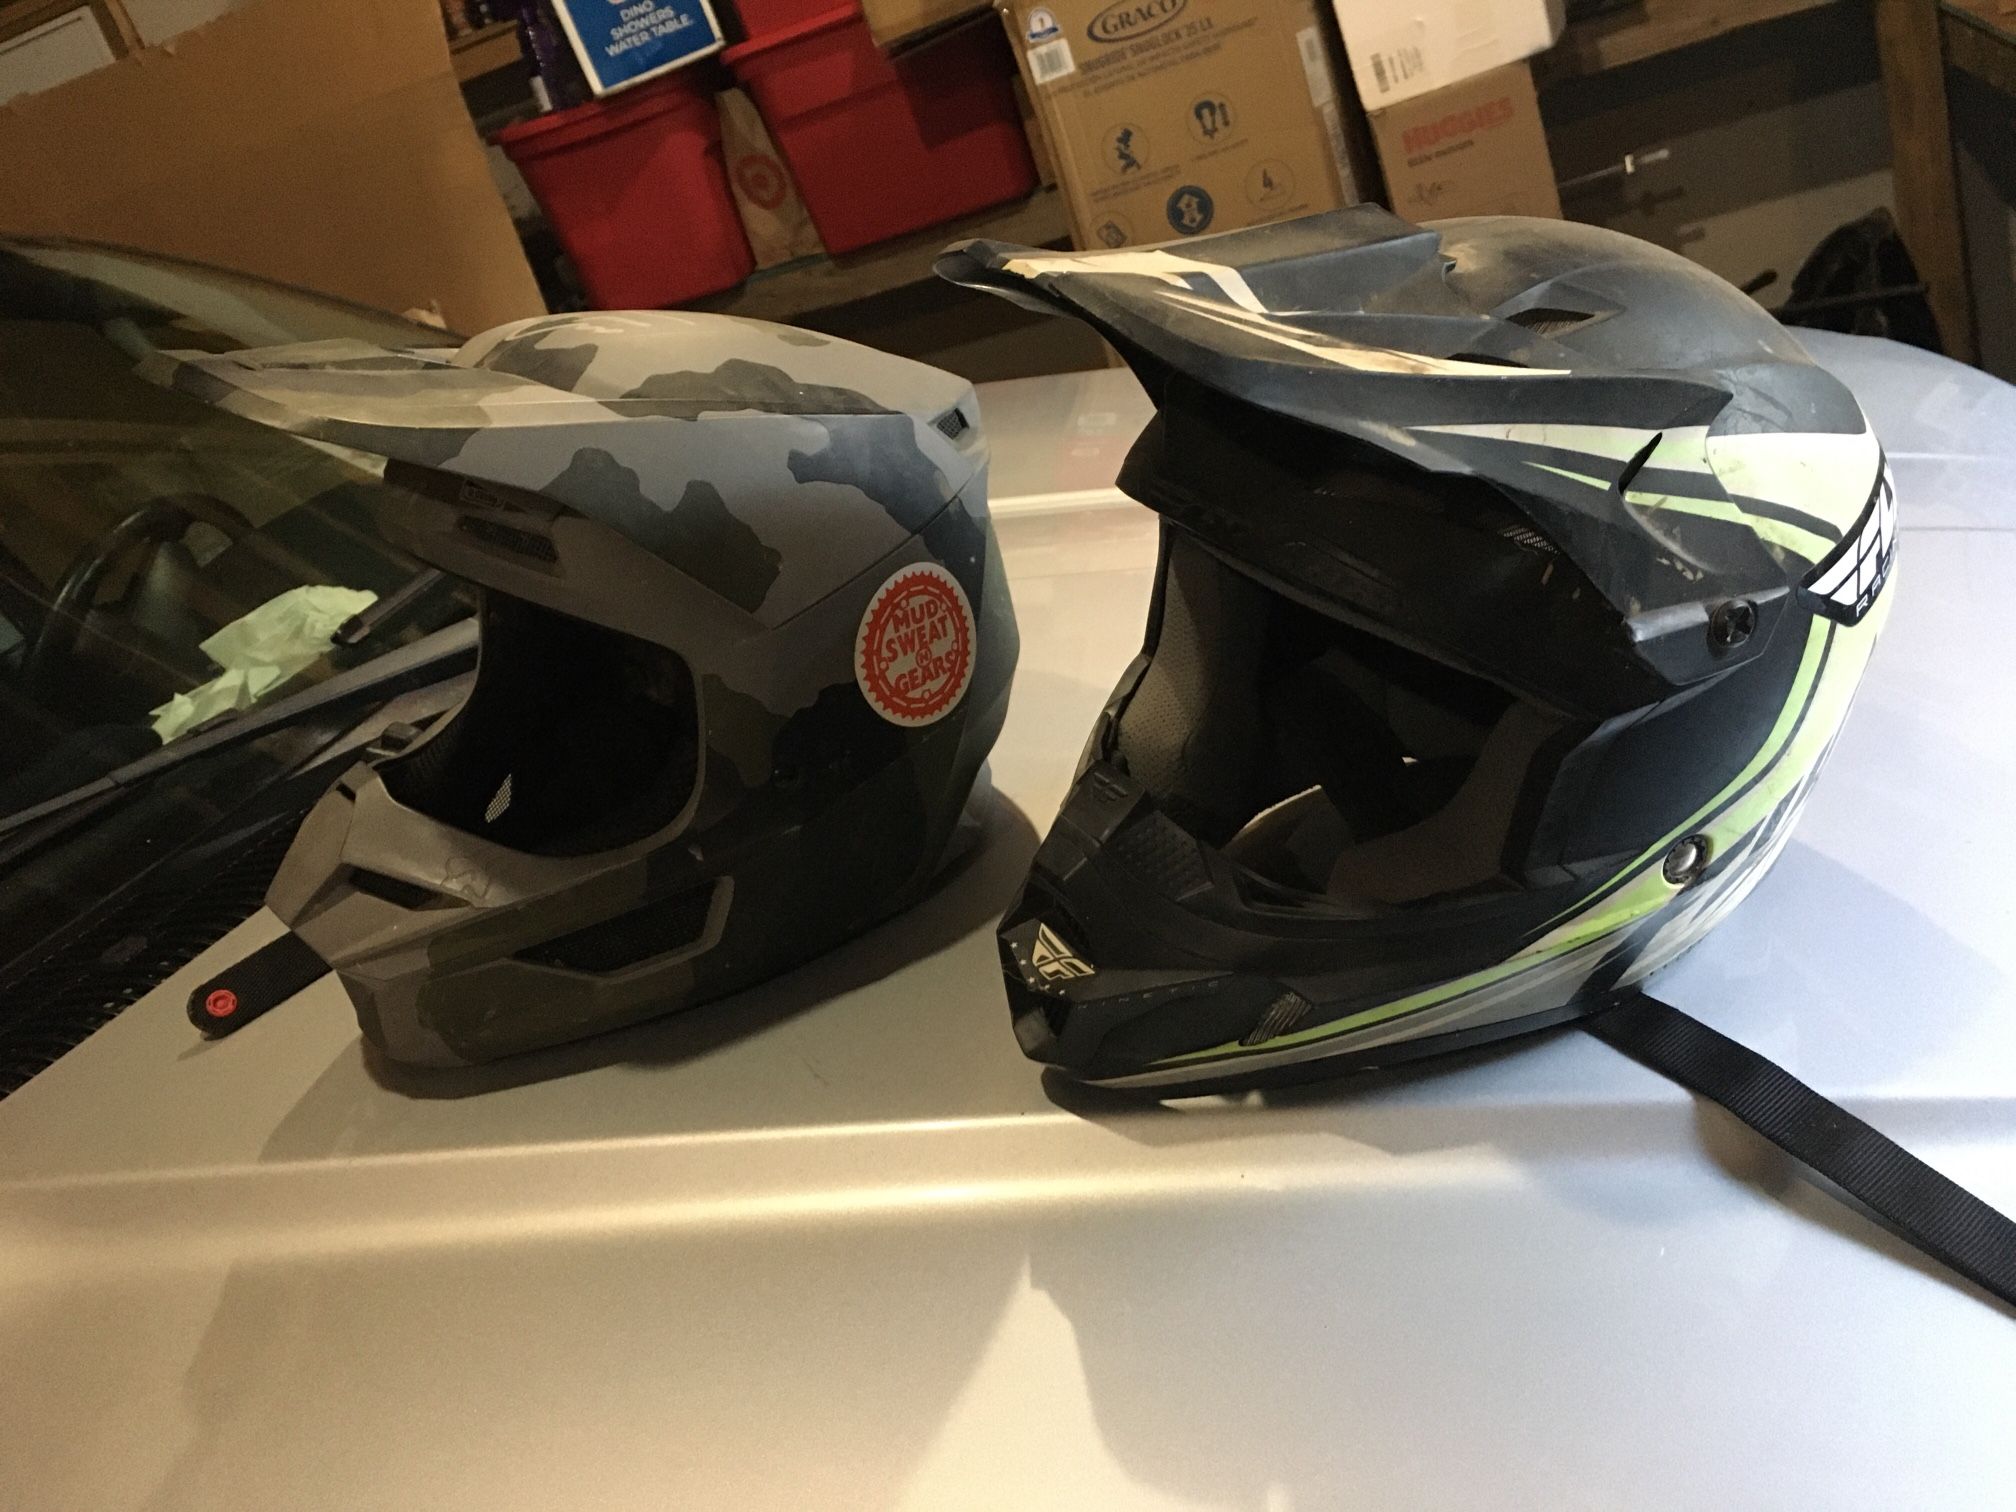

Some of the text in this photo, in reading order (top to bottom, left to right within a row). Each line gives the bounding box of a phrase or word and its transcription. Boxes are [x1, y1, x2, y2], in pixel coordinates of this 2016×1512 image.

[610, 6, 674, 40] SHOWERS
[620, 0, 655, 21] DINO
[1101, 0, 1177, 35] GRACO
[605, 31, 649, 57] WATER
[893, 600, 939, 633] MUD
[886, 614, 949, 662] SWEAT
[895, 651, 956, 695] GEARS
